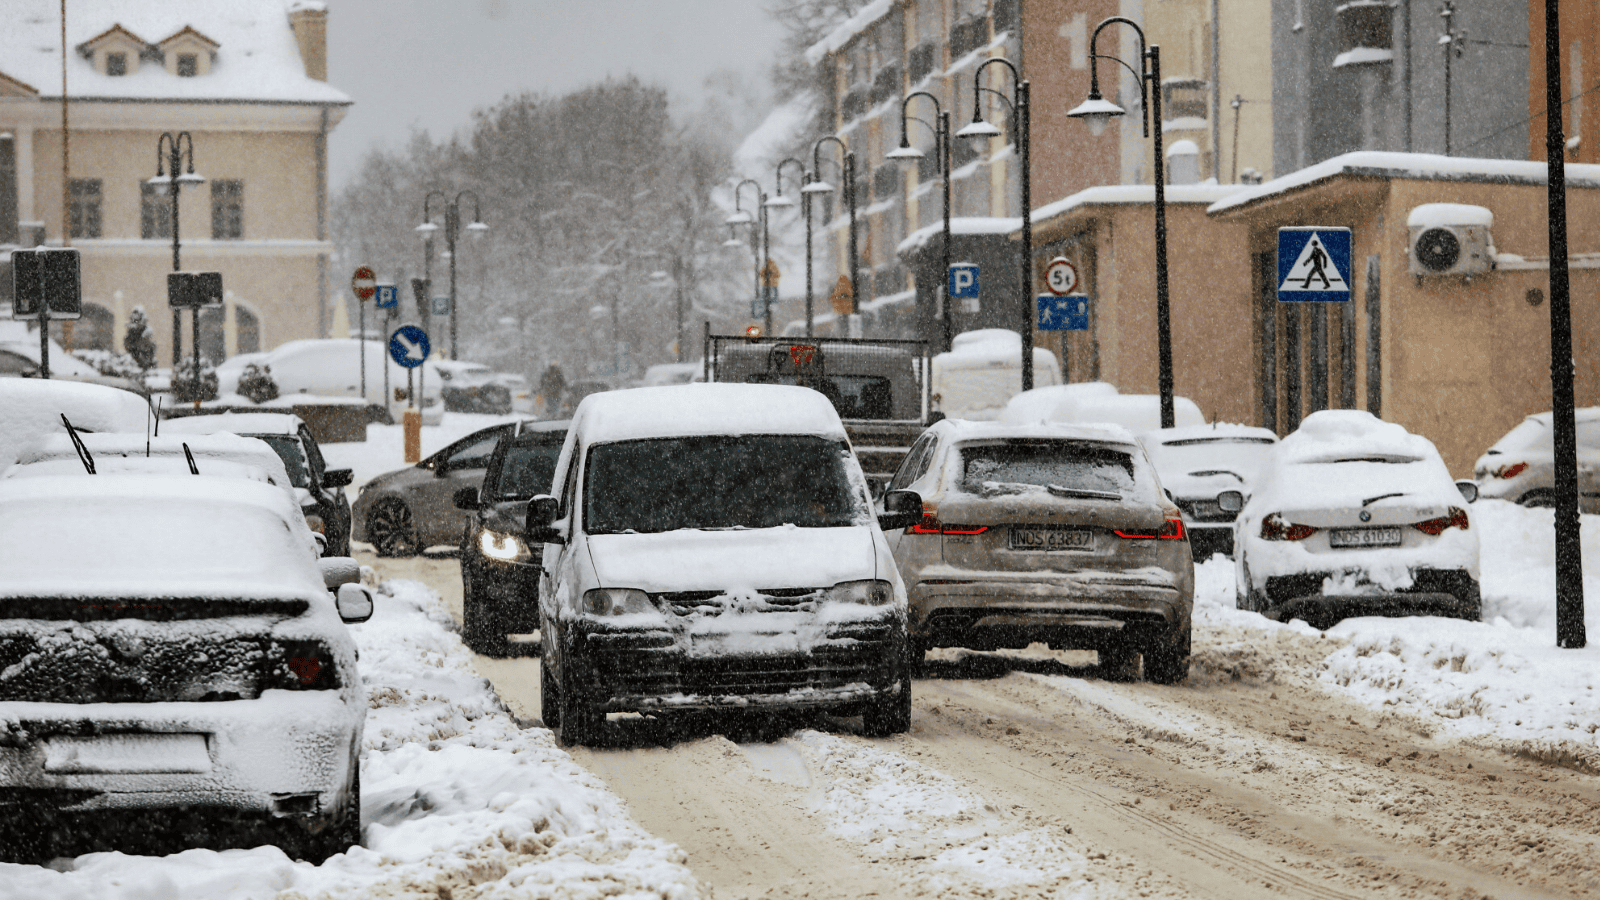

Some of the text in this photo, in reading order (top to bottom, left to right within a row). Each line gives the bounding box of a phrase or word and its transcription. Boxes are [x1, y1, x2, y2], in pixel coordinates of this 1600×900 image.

[954, 269, 974, 294] P
[380, 287, 393, 305] P
[1016, 531, 1091, 546] NOS 63837
